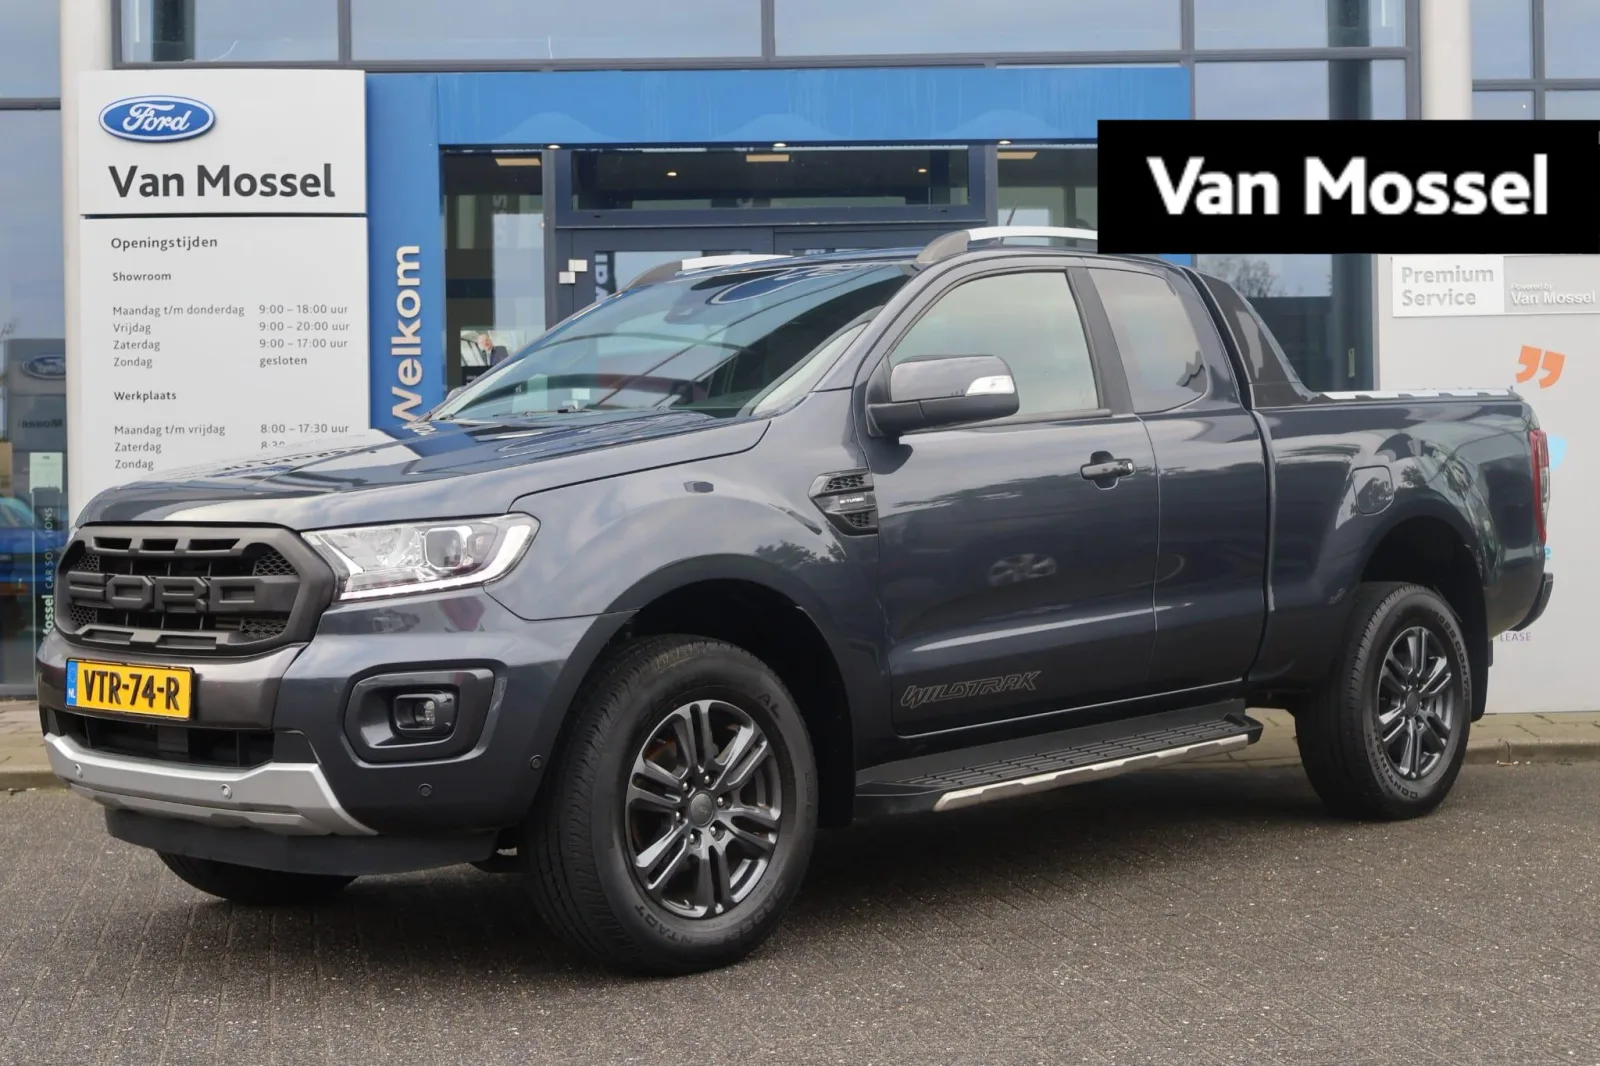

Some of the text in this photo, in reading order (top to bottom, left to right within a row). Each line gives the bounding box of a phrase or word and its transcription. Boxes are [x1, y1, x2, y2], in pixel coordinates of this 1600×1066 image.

[122, 102, 191, 133] Ford
[107, 162, 336, 198] Van Mossel
[110, 235, 218, 252] Openingstijden
[112, 271, 172, 282] Showroom
[1401, 265, 1494, 284] Premium
[1401, 287, 1477, 307] Service
[1511, 289, 1596, 305] Van Mossel
[112, 304, 245, 318] Maandag t/m donderdag
[258, 304, 284, 315] 9:00
[297, 304, 328, 314] 18:00
[330, 305, 348, 314] uur
[112, 322, 152, 336] Vrijdag
[259, 321, 284, 332] 9:00
[296, 321, 329, 331] 20:00
[331, 322, 350, 332] uur
[391, 245, 423, 426] Welkom
[113, 339, 161, 353] Zaterdag
[259, 338, 285, 349] 9:00
[297, 338, 327, 348] 17:00
[329, 340, 348, 349] uur
[113, 356, 153, 370] Zondag
[259, 355, 308, 369] gesloten
[113, 389, 177, 403] Werkplaats
[114, 424, 226, 437] Maandag t/m vrijdag
[260, 423, 286, 434] 8:00
[298, 423, 328, 434] 17:30
[331, 425, 349, 433] uur
[114, 441, 162, 455] Zaterdag
[114, 458, 155, 471] Zondag
[68, 571, 262, 614] FORD
[68, 687, 76, 699] NL
[83, 669, 180, 711] VTR-74-R
[900, 670, 1042, 709] WILDTRAK
